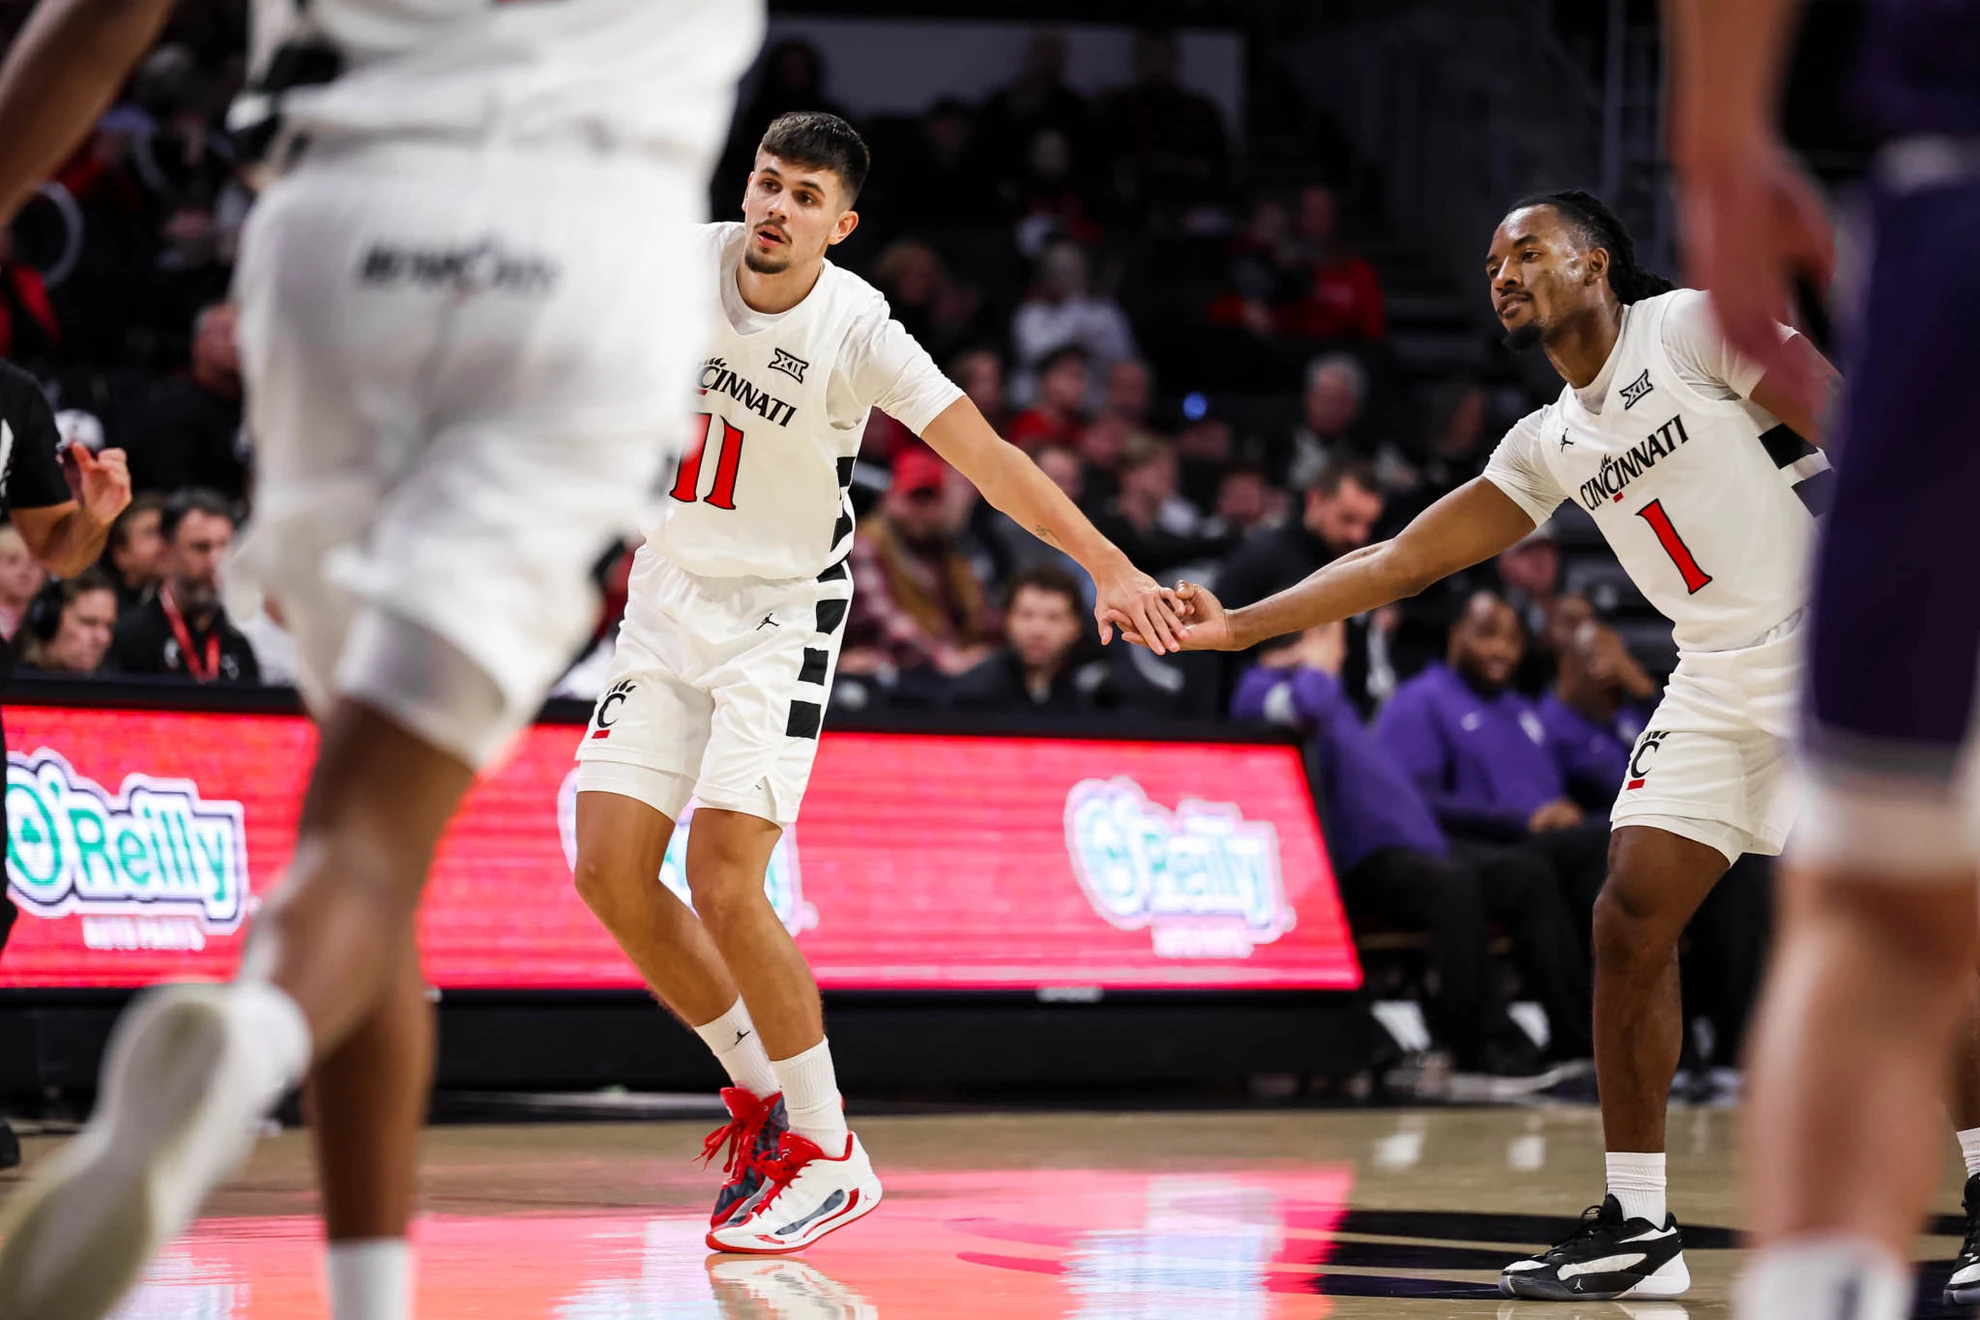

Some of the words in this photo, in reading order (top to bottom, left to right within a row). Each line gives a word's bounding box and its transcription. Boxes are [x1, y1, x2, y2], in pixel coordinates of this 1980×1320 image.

[697, 359, 797, 427] CINNATI
[669, 412, 744, 510] 11
[1579, 414, 1689, 511] CINCINNATI
[1635, 499, 1713, 595] 1
[7, 781, 226, 902] O'Reilly
